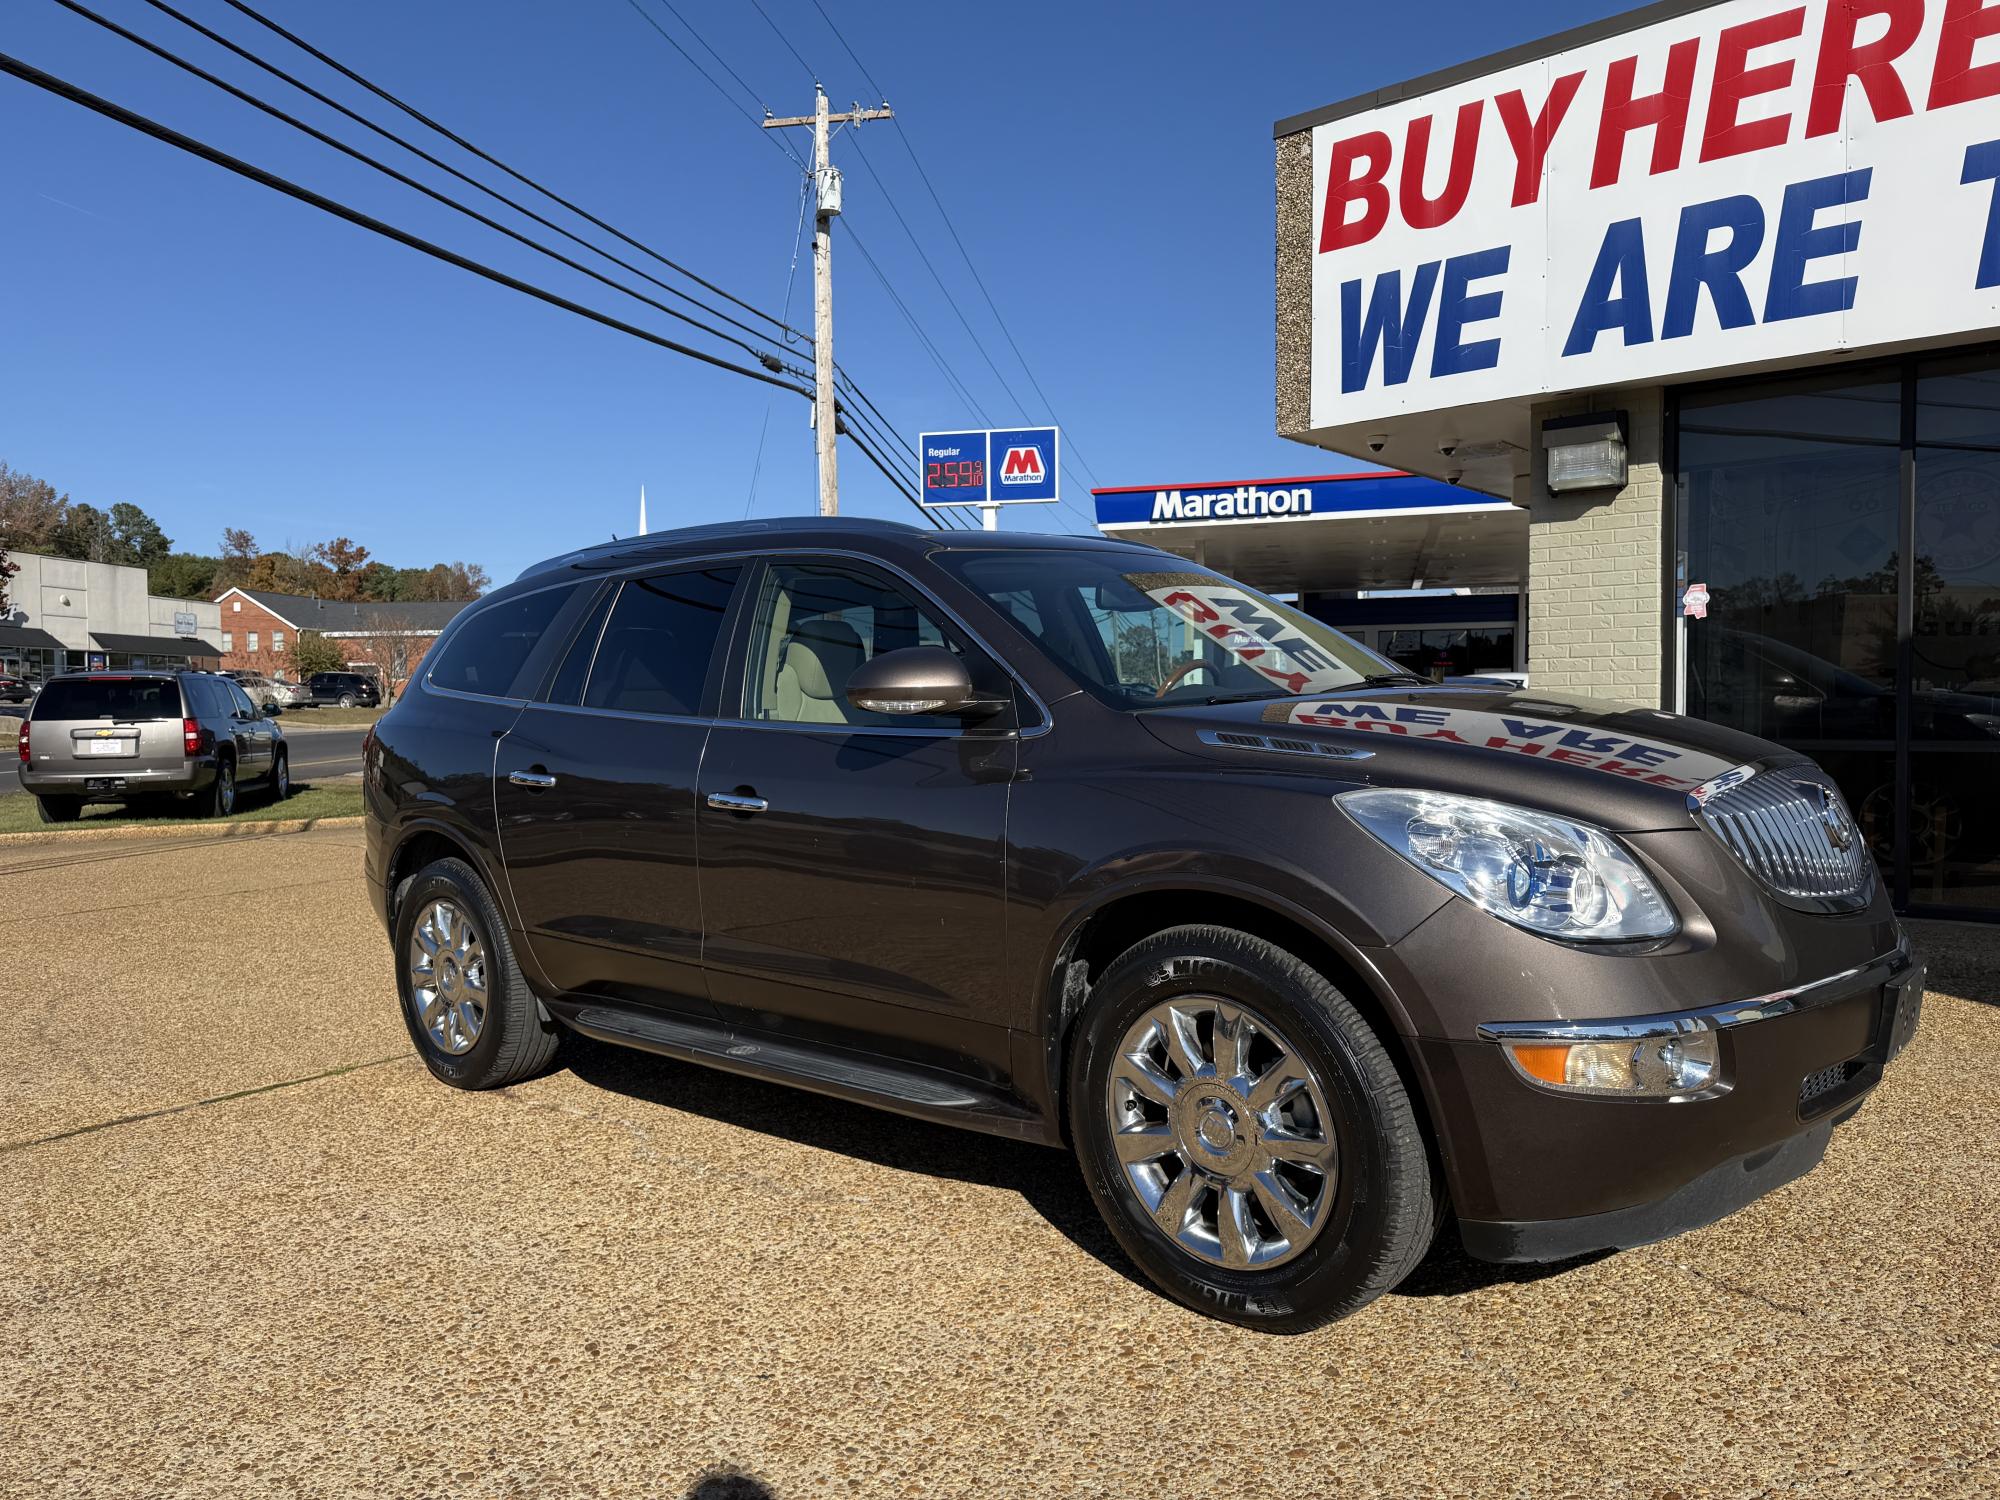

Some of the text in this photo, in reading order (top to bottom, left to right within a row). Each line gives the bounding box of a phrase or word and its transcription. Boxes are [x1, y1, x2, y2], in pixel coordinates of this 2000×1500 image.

[1340, 245, 1511, 394] WE
[1561, 167, 1873, 357] ARE
[928, 447, 961, 458] Regular
[1003, 474, 1042, 482] Marathon
[1152, 486, 1312, 519] Marathon
